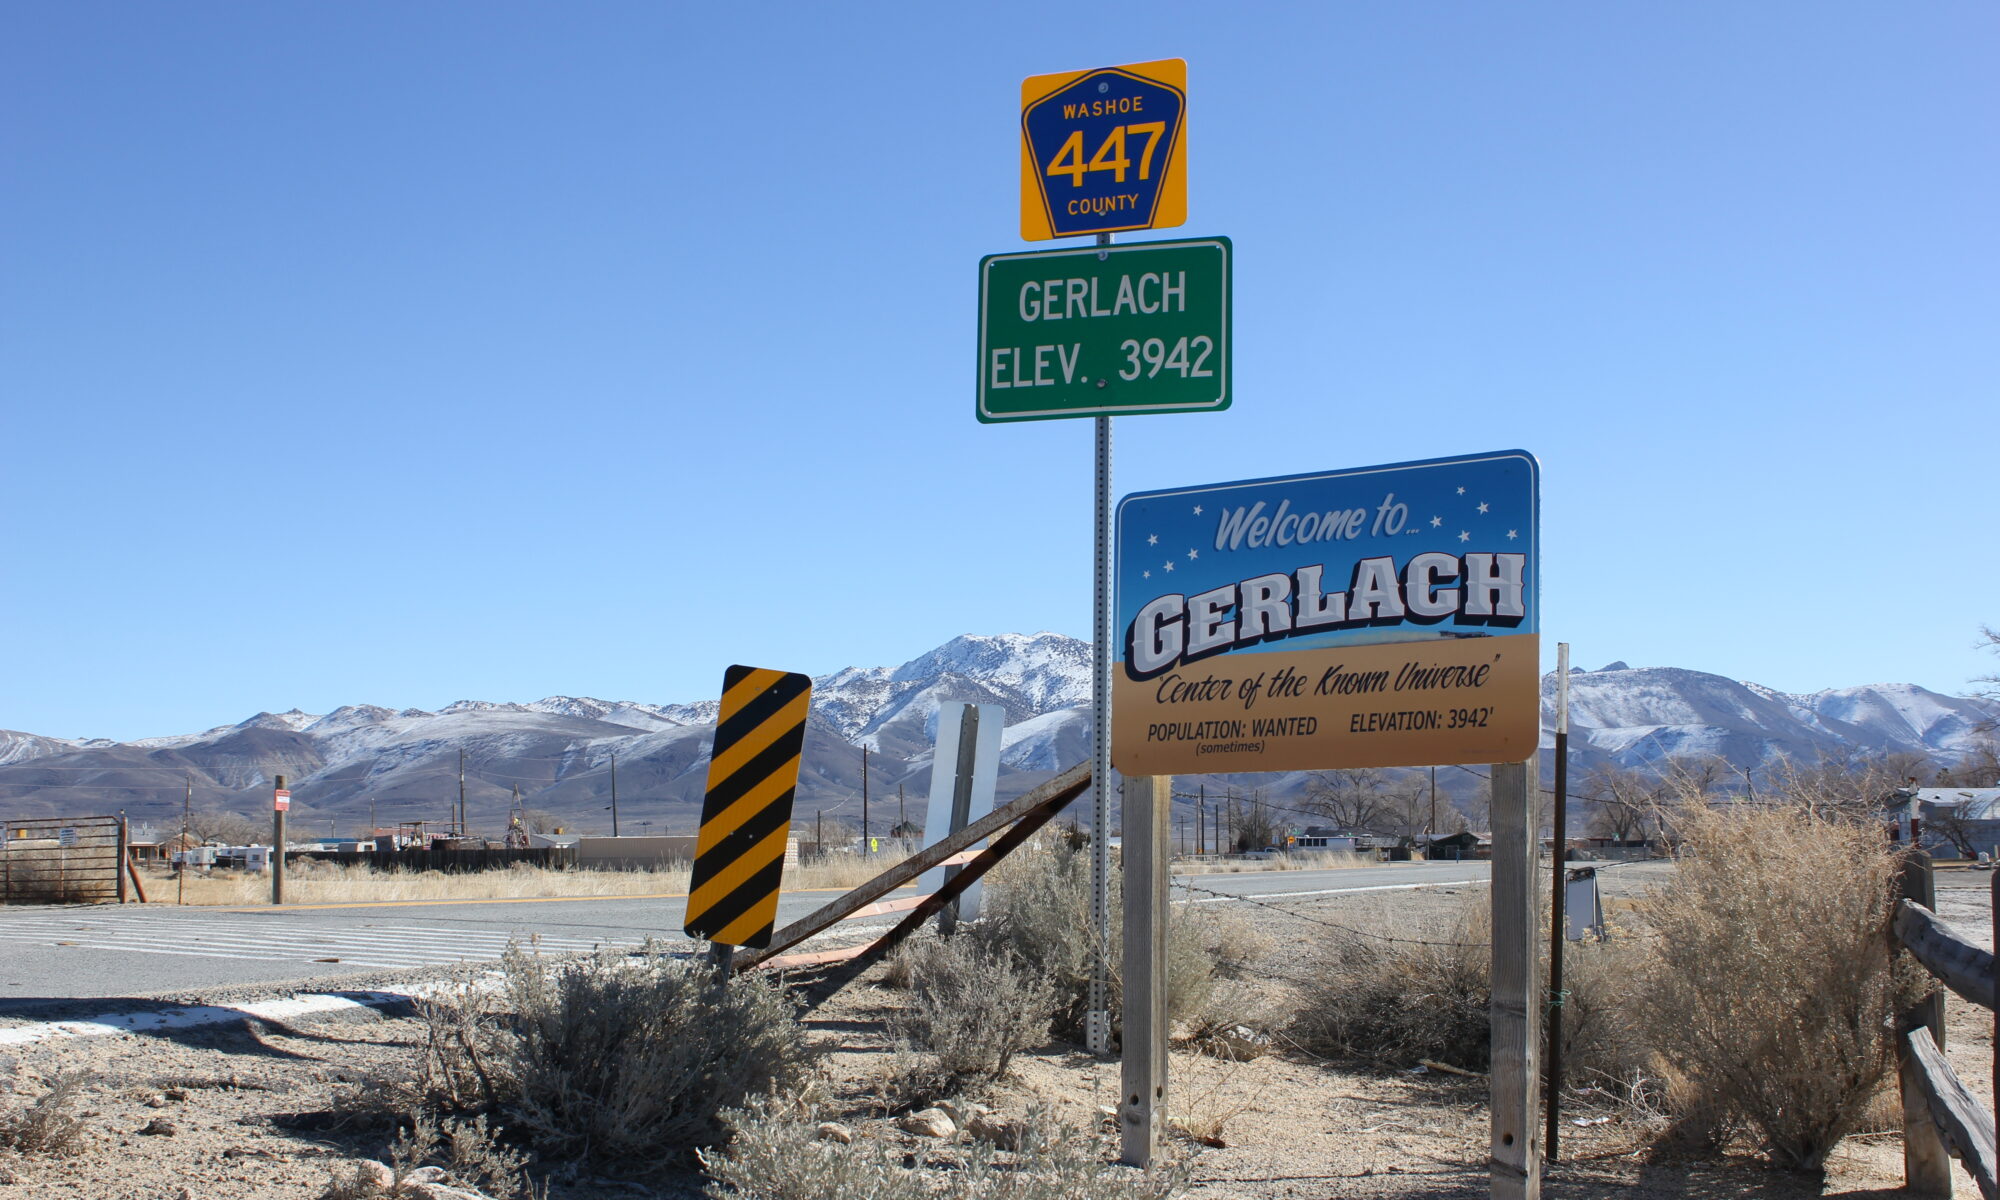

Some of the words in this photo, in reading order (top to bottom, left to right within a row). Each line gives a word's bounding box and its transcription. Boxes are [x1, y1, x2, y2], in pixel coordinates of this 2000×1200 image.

[1063, 96, 1143, 119] WASHOE
[1046, 121, 1166, 187] 447
[1067, 193, 1139, 216] COUNTY
[1019, 271, 1186, 322] GERLACH
[991, 343, 1088, 389] ELEV.
[1118, 335, 1213, 381] 3942
[1214, 498, 1367, 551] Welcome
[1371, 492, 1420, 537] to...
[1124, 551, 1527, 682] GERLACH
[1238, 672, 1266, 710] of
[1267, 666, 1308, 697] the
[1313, 664, 1390, 696] Known
[1147, 719, 1247, 742] POPULATION:
[1252, 717, 1318, 737] WANTED
[1350, 710, 1443, 732] ELEVATION:
[1447, 706, 1494, 729] 3942'
[1196, 740, 1265, 756] (sometimes)
